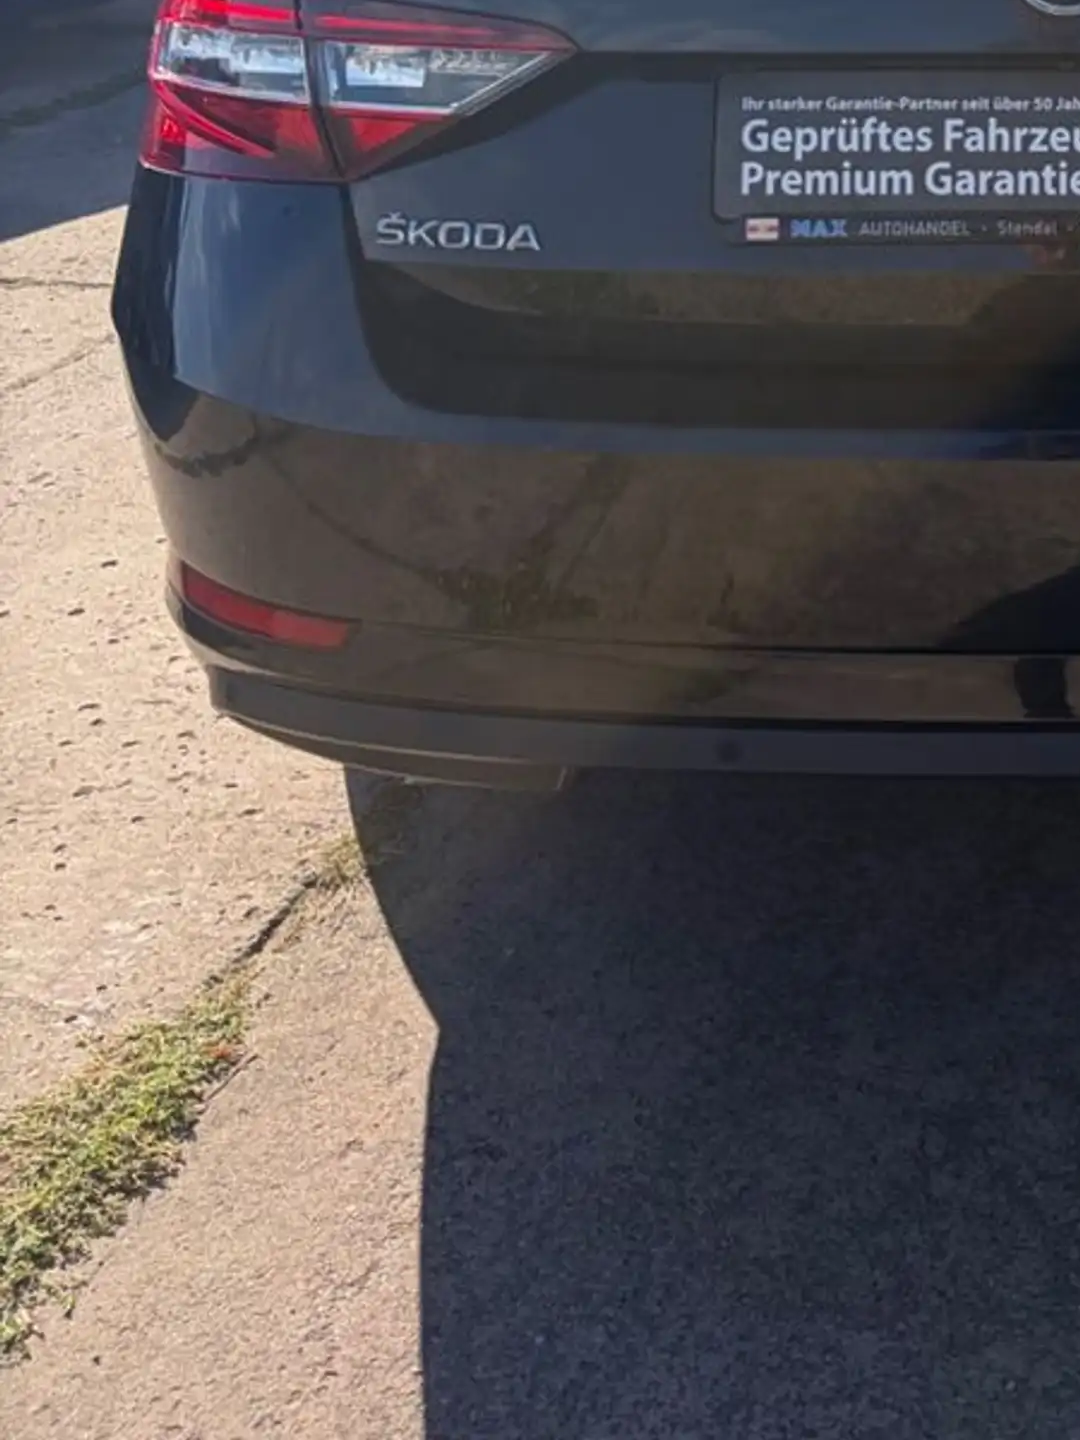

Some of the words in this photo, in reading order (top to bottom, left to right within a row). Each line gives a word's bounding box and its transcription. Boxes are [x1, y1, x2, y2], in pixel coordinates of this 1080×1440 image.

[741, 96, 764, 110] Ihr
[768, 96, 822, 110] starker
[825, 96, 957, 111] Garantie-Partner
[962, 97, 990, 110] seit
[993, 96, 1029, 111] über
[1032, 97, 1053, 110] 50
[741, 116, 933, 162] Geprüftes
[741, 161, 914, 196] Premium
[376, 211, 541, 251] ŠKODA
[790, 219, 849, 237] MAX
[858, 220, 971, 236] AUTOHANDEL
